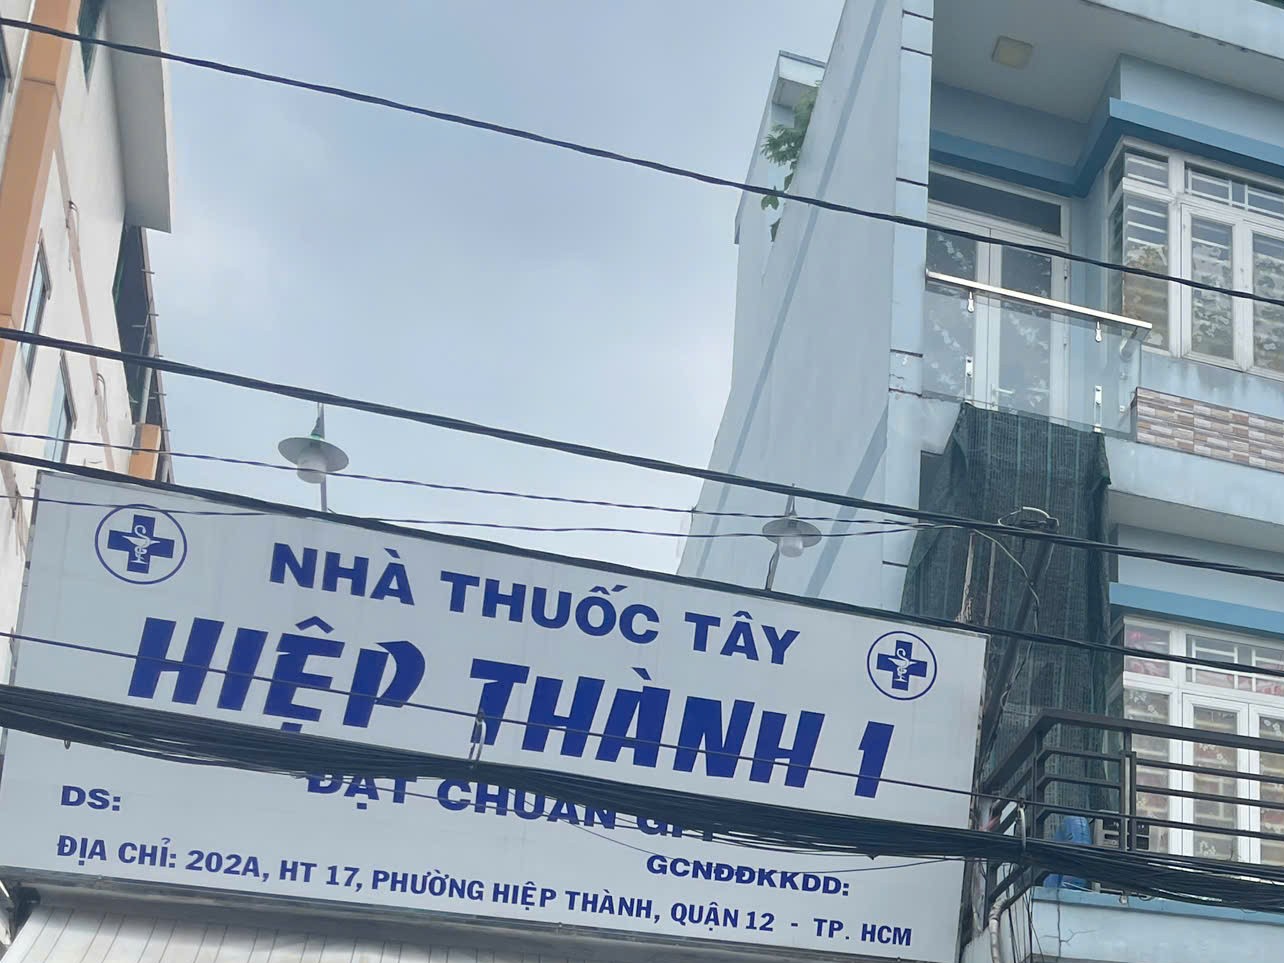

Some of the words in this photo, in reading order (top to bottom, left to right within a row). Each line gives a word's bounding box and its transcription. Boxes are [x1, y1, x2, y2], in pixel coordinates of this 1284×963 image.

[270, 543, 415, 606] NHÀ
[440, 570, 660, 645] THUỐC
[684, 611, 801, 666] TÂY
[127, 615, 426, 732] HIỆP
[469, 657, 825, 789] THÀNH
[854, 720, 894, 799] 1
[60, 785, 121, 812] DS:
[57, 836, 107, 867] ĐỊA
[118, 837, 178, 871] CHỈ:
[185, 850, 270, 883] 202A,
[279, 860, 317, 884] HT
[326, 864, 363, 893] 17,
[371, 867, 485, 904] PHƯỜNG
[491, 880, 557, 909] HIỆP
[565, 888, 660, 925] THÀNH,
[670, 901, 739, 929] QUẬN
[746, 912, 775, 932] 12
[814, 918, 850, 940] TP.
[861, 923, 912, 946] HCM
[646, 854, 850, 896] GCNĐĐKKDD:
